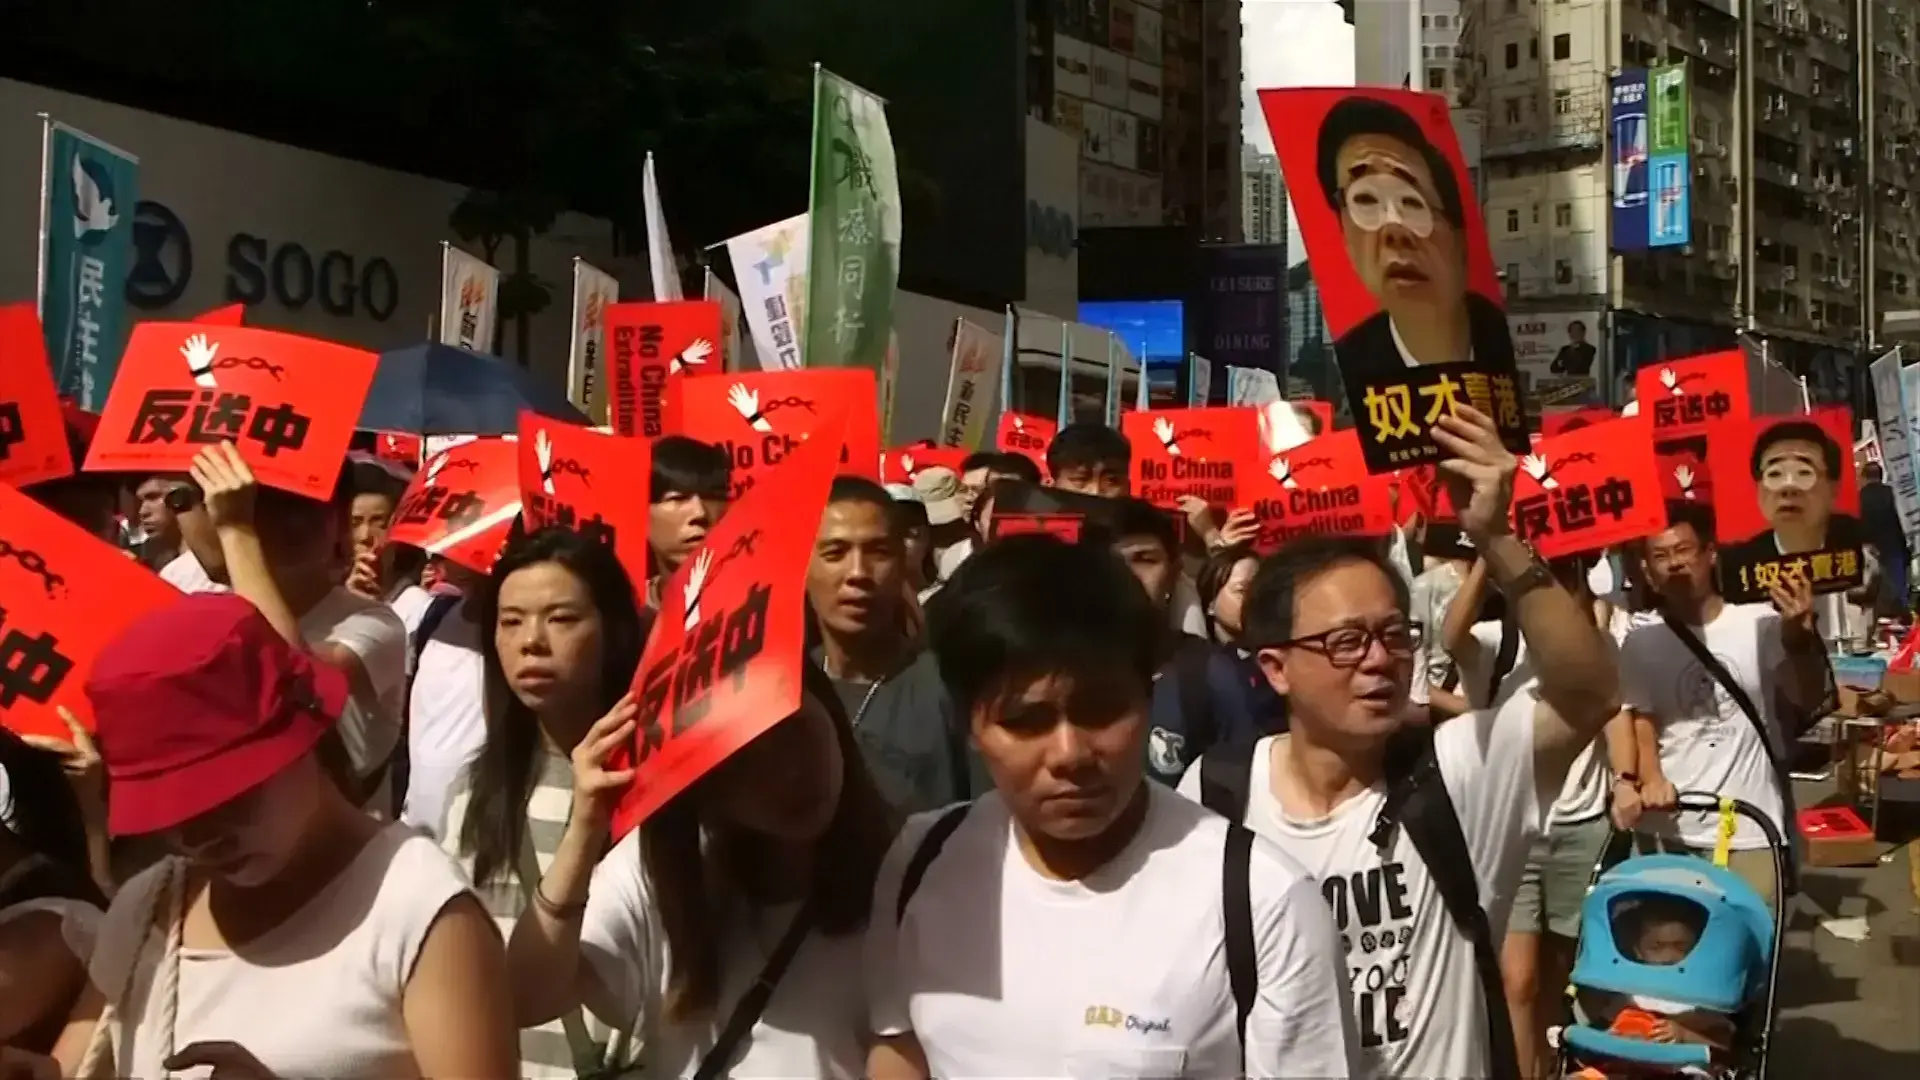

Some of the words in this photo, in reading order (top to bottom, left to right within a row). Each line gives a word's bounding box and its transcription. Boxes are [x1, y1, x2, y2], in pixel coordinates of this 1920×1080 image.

[226, 232, 399, 321] SOGO
[1210, 276, 1276, 292] LEISURE
[639, 326, 665, 358] No
[1214, 333, 1271, 350] DINING
[640, 365, 667, 436] China
[1652, 391, 1731, 428] 反送中
[127, 389, 312, 457] 反送中
[1141, 459, 1167, 480] No
[1172, 456, 1234, 479] China
[393, 486, 486, 532] 送中
[1253, 496, 1285, 521] No
[1289, 484, 1360, 516] China
[1515, 475, 1634, 540] 反送中
[632, 582, 772, 764] 反送中
